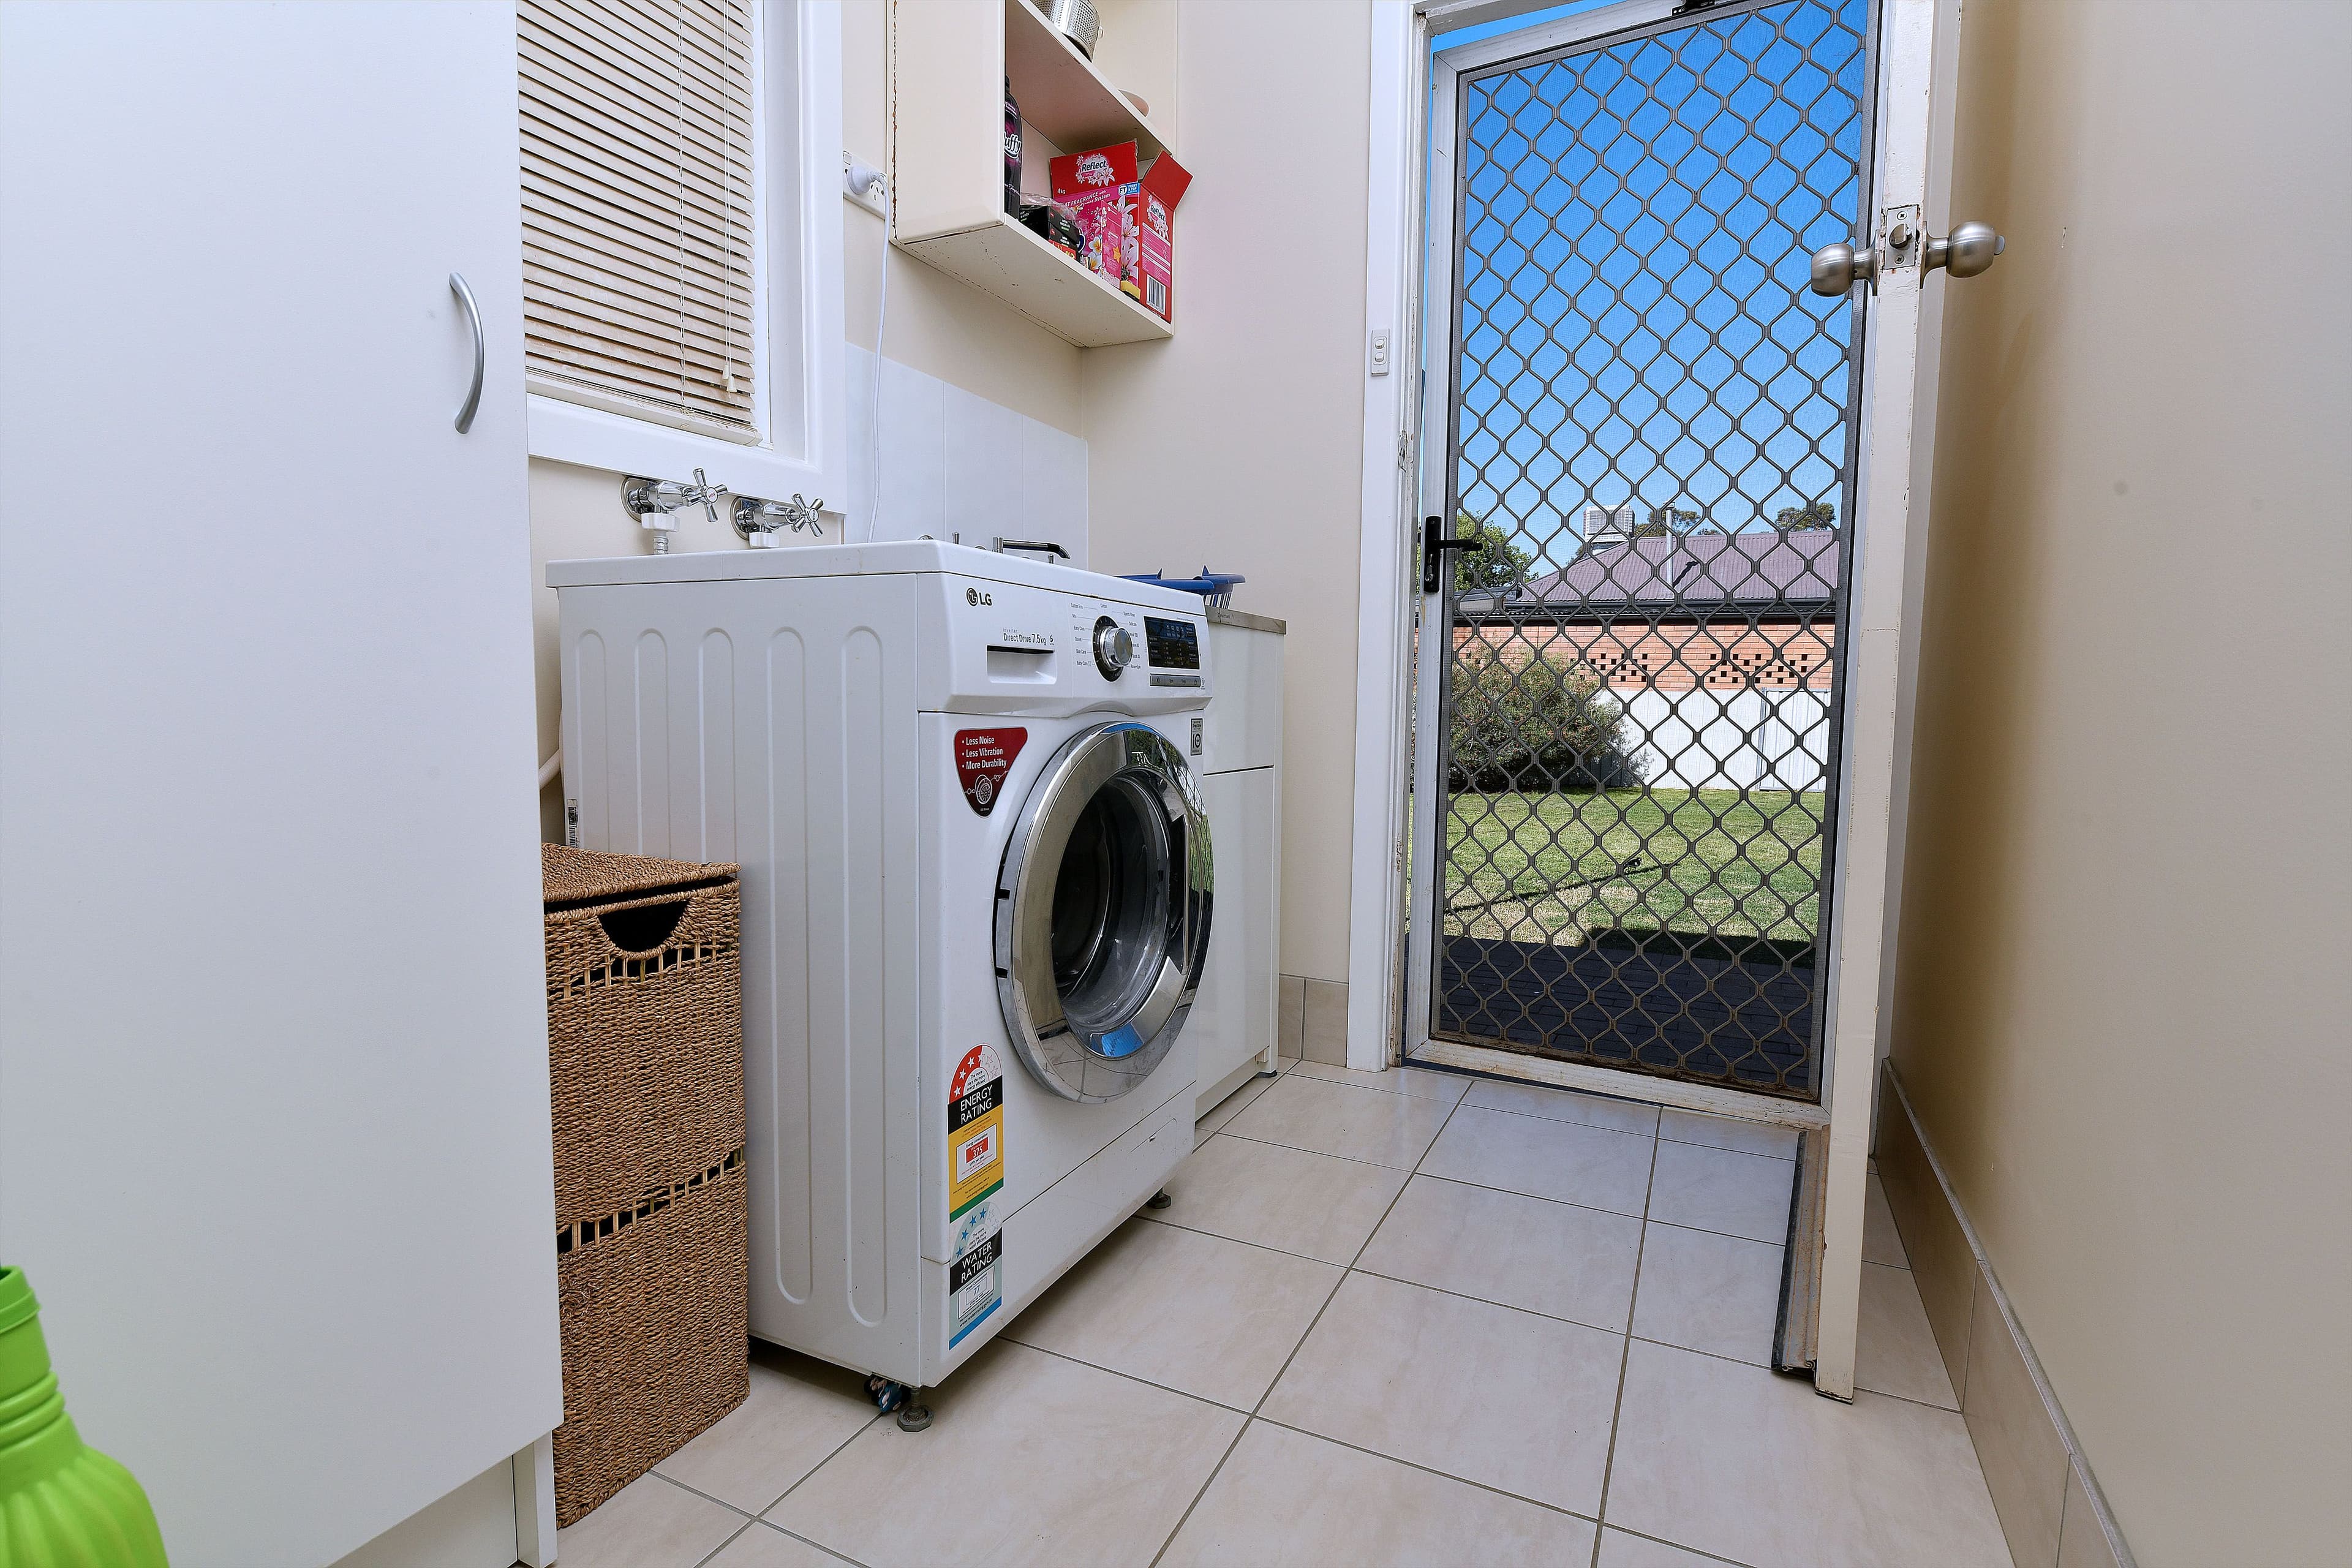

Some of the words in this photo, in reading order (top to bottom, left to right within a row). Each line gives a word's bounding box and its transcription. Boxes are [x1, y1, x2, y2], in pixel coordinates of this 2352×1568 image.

[1005, 133, 1021, 153] uffy
[1082, 160, 1106, 172] Reflect
[1071, 191, 1098, 206] FRAGRANCE
[1095, 193, 1110, 202] System
[1151, 205, 1165, 221] Reflect
[979, 592, 992, 606] LG
[1003, 633, 1018, 642] Direct
[1019, 635, 1031, 643] Drive
[1031, 633, 1046, 646] 7.5kg
[966, 737, 978, 745] Less
[979, 736, 995, 744] Noise
[966, 749, 978, 758] Less
[979, 747, 1003, 756] Vibration
[966, 761, 981, 770] More
[981, 758, 1007, 768] Durability
[960, 1085, 992, 1112] ENERGY
[961, 1098, 992, 1125] RATING
[973, 1145, 982, 1158] 375
[962, 1242, 992, 1268] WATER
[961, 1253, 992, 1283] RATING
[974, 1285, 980, 1295] 77
